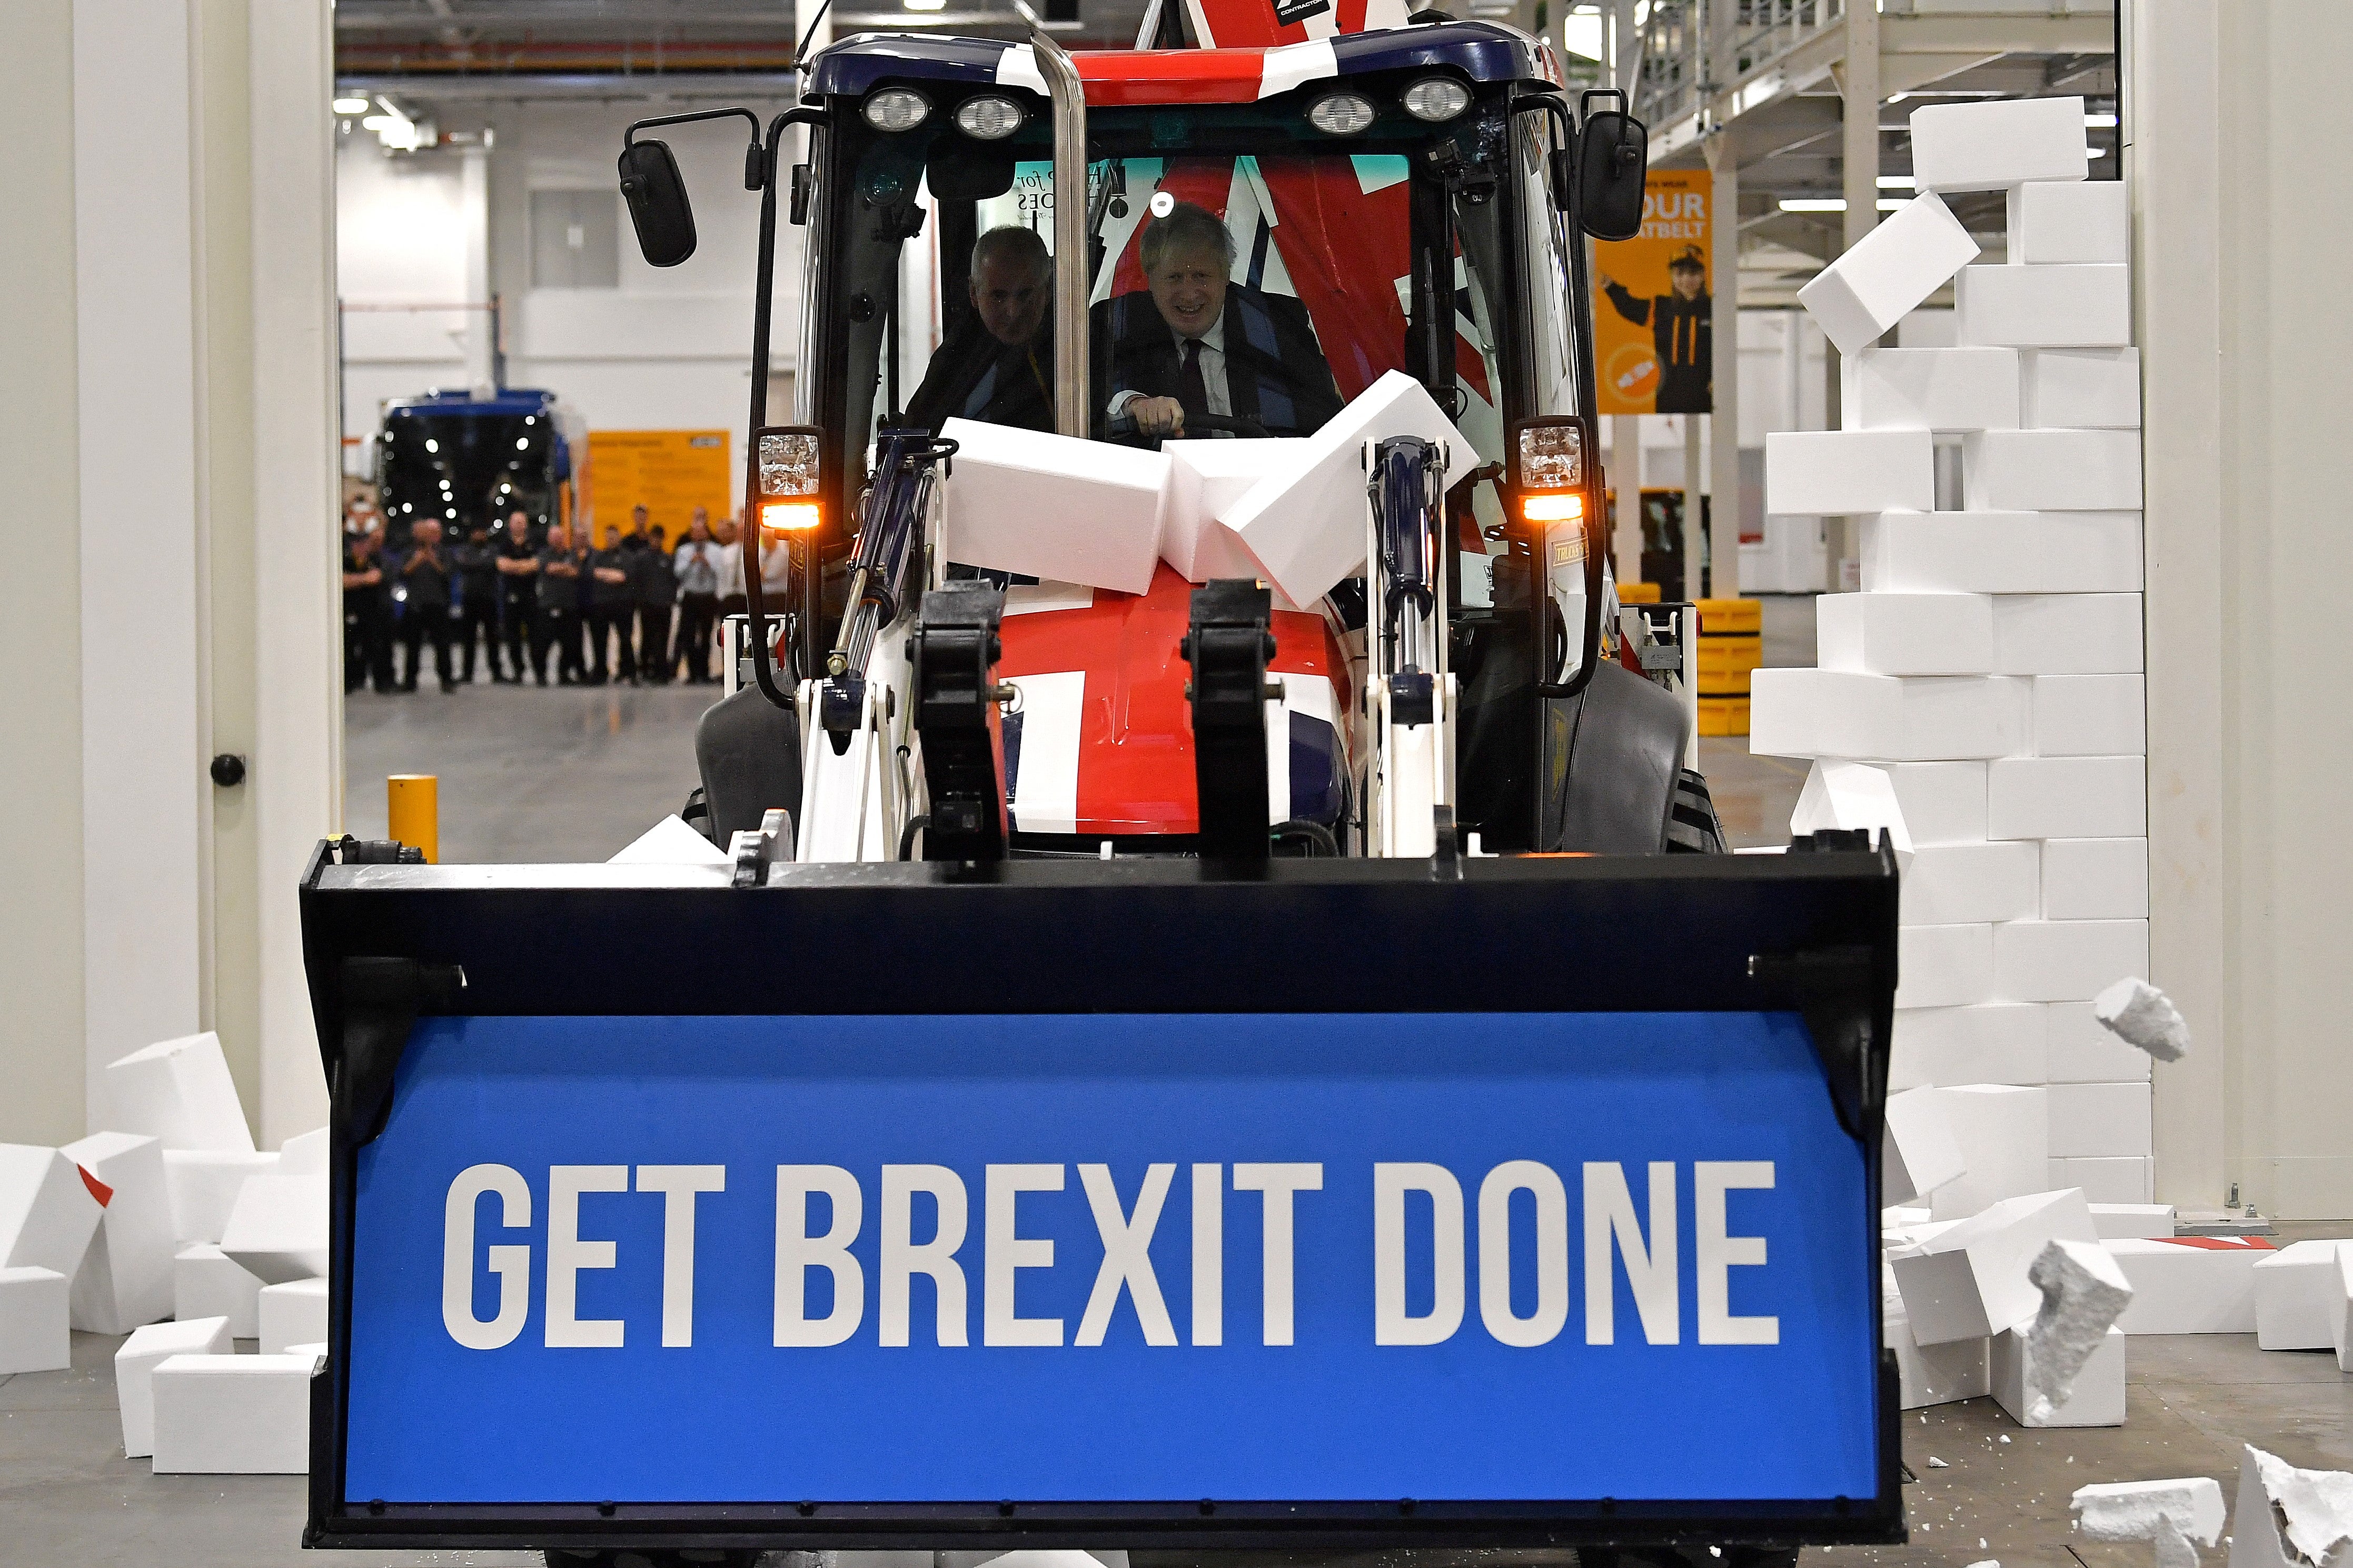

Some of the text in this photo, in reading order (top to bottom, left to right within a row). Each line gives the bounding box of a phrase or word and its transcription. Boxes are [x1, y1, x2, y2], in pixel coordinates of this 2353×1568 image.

[1642, 193, 1705, 219] OUR
[1639, 222, 1706, 238] TBELT
[443, 1161, 1780, 1350] GET BREXIT DONE
